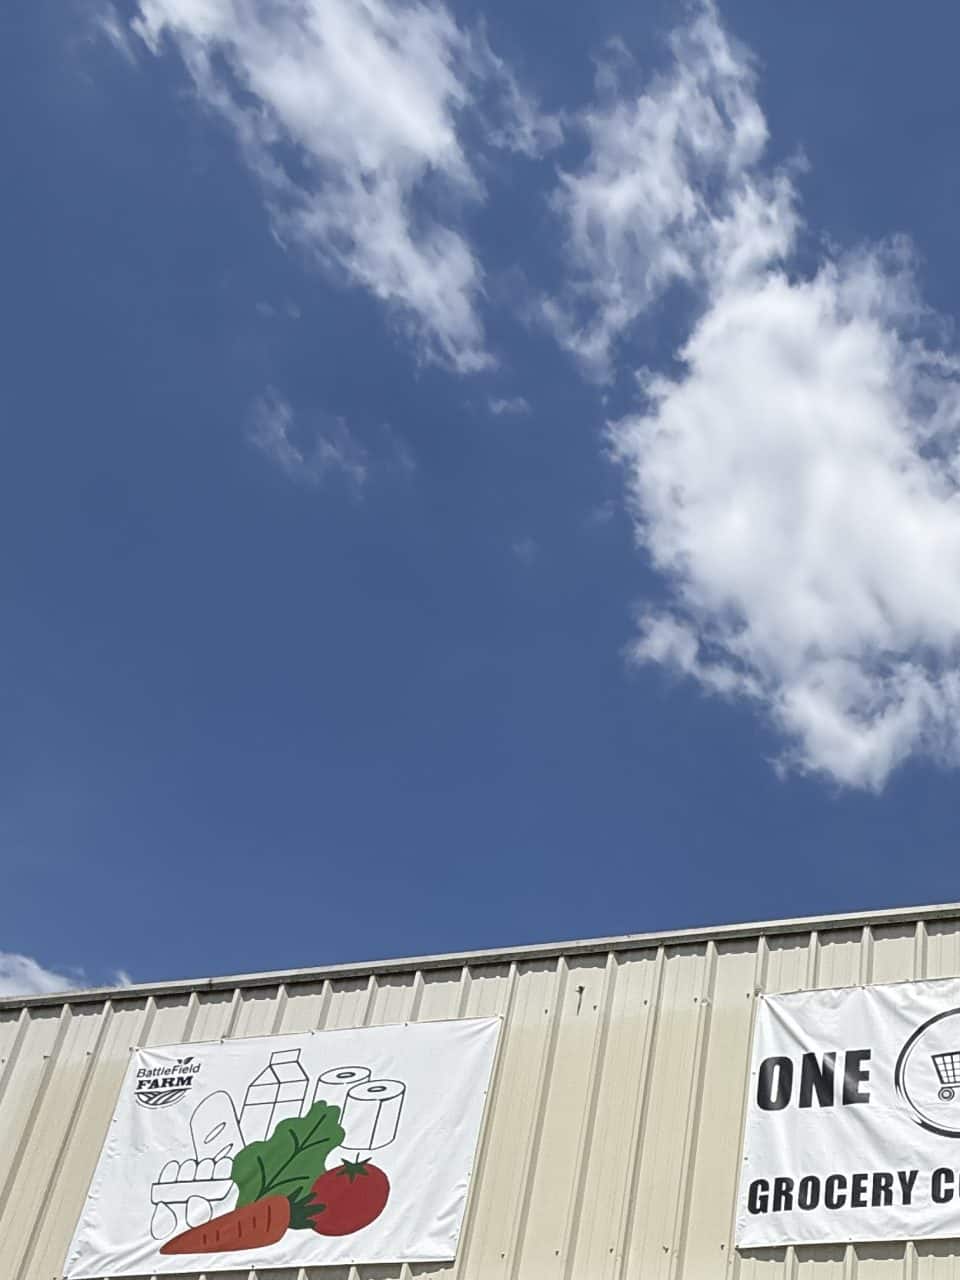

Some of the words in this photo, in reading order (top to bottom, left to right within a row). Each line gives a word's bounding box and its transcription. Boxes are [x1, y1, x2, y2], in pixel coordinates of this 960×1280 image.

[136, 1063, 201, 1077] BattleField
[136, 1076, 193, 1090] FARM
[757, 1049, 871, 1111] ONE
[748, 1170, 918, 1214] GROCERY
